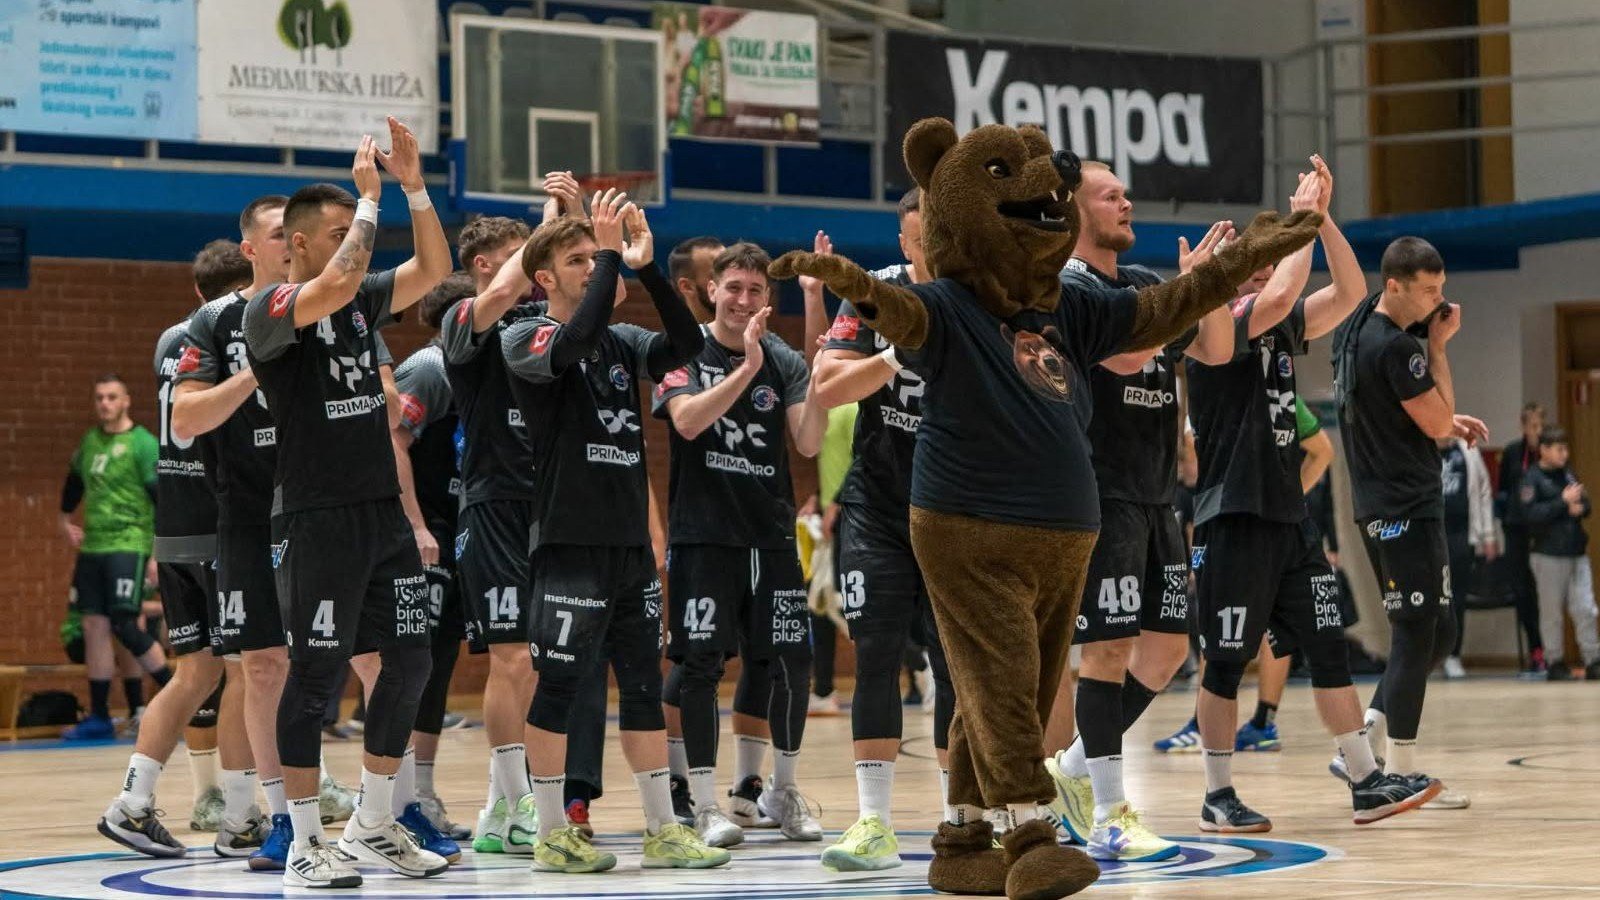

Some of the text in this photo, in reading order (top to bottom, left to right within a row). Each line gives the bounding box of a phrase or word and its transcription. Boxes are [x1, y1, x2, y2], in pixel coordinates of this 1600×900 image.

[370, 72, 424, 98] HIŽA
[945, 47, 1211, 191] Kempa
[316, 315, 336, 346] 4
[544, 594, 608, 608] metaloBox
[1097, 575, 1141, 614] 48
[1162, 589, 1186, 605] biro
[484, 586, 520, 621] 14
[1314, 600, 1337, 616] biro
[312, 599, 336, 637] 4
[396, 605, 424, 620] biro
[683, 597, 717, 632] 42
[1105, 615, 1137, 625] Kempa
[489, 621, 517, 630] Kempa
[555, 610, 573, 647] 7
[772, 615, 800, 629] biro
[1217, 606, 1247, 640] 17
[308, 637, 339, 648] Kempa
[688, 632, 712, 640] Kempa
[546, 649, 575, 662] Kempa
